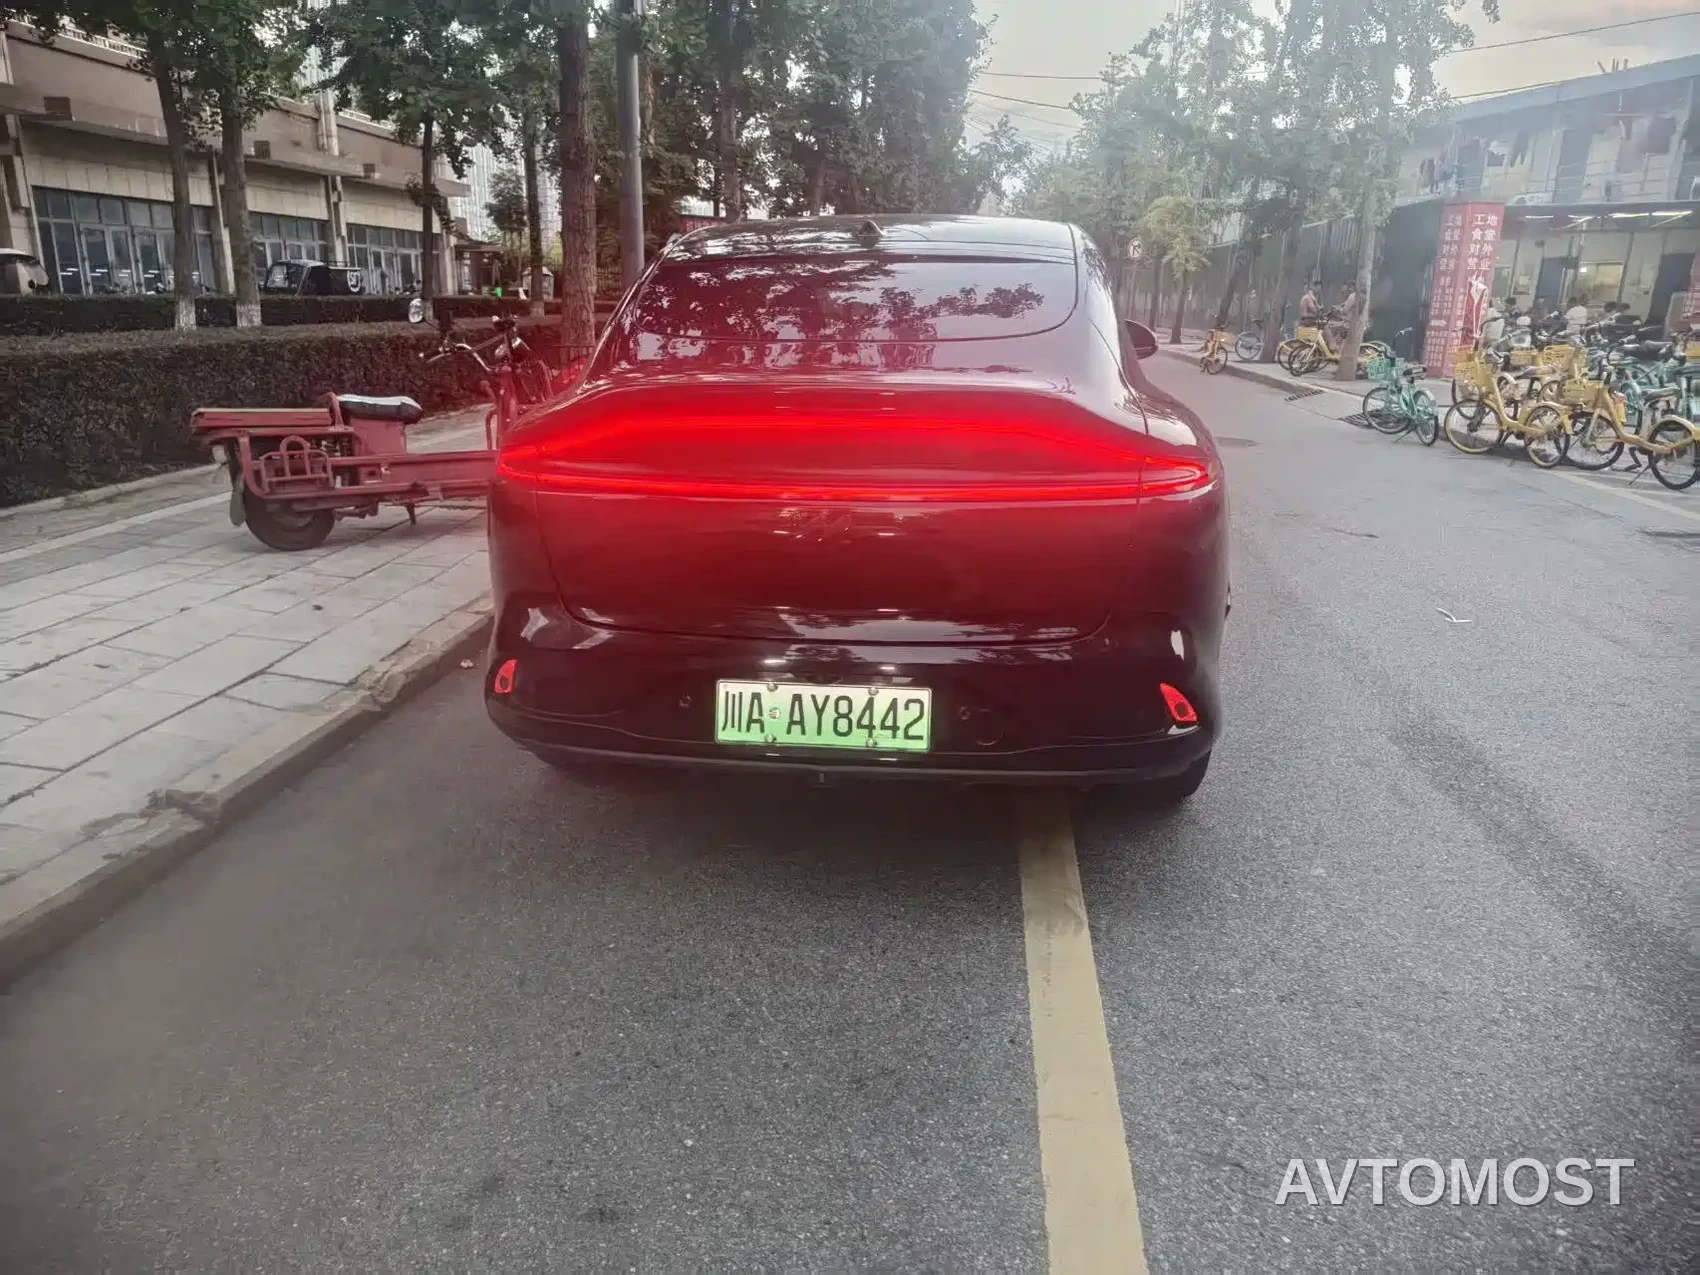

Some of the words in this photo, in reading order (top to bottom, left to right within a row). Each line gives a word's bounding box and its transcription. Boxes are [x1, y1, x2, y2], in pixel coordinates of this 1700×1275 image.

[1473, 213, 1498, 227] 工地
[1471, 228, 1496, 241] 食堂
[1468, 242, 1493, 256] 对外
[1466, 256, 1491, 271] 营业
[721, 690, 765, 734] 川A
[786, 693, 925, 741] AY8442
